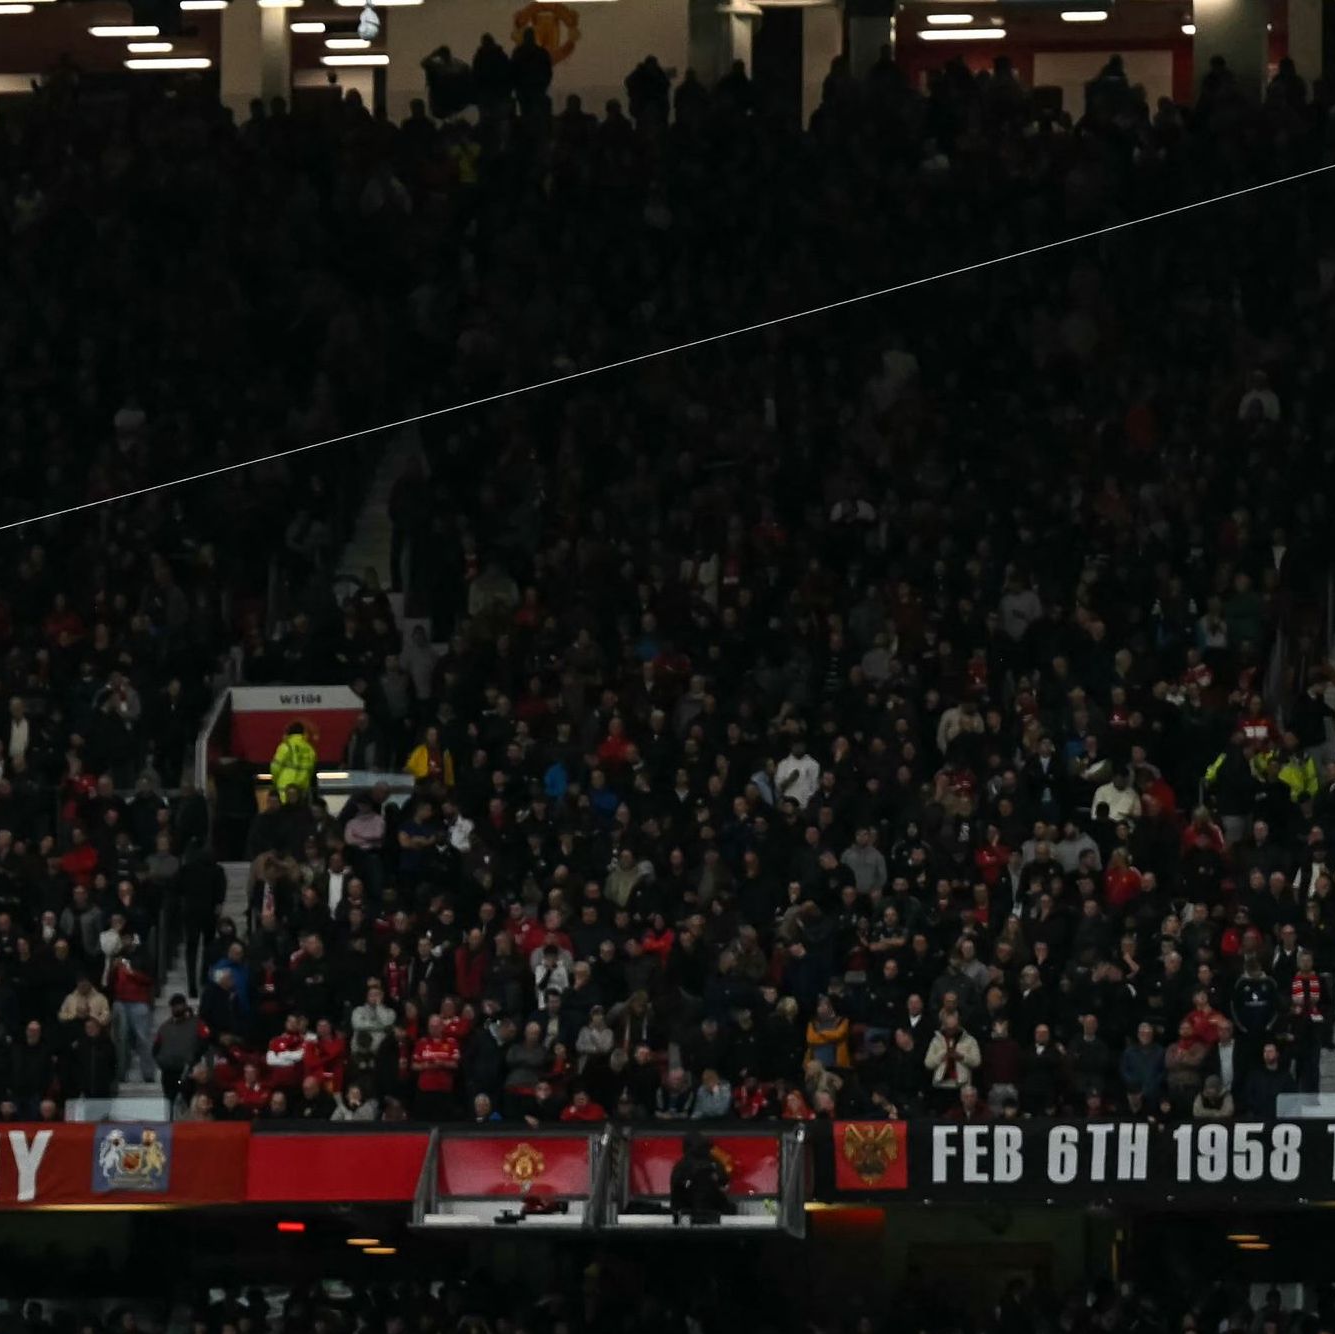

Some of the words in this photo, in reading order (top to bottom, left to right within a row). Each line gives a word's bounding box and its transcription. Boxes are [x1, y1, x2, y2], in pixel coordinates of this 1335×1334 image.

[932, 1123, 1023, 1183] FEB
[1047, 1122, 1149, 1183] 6TH
[1173, 1121, 1302, 1182] 1958
